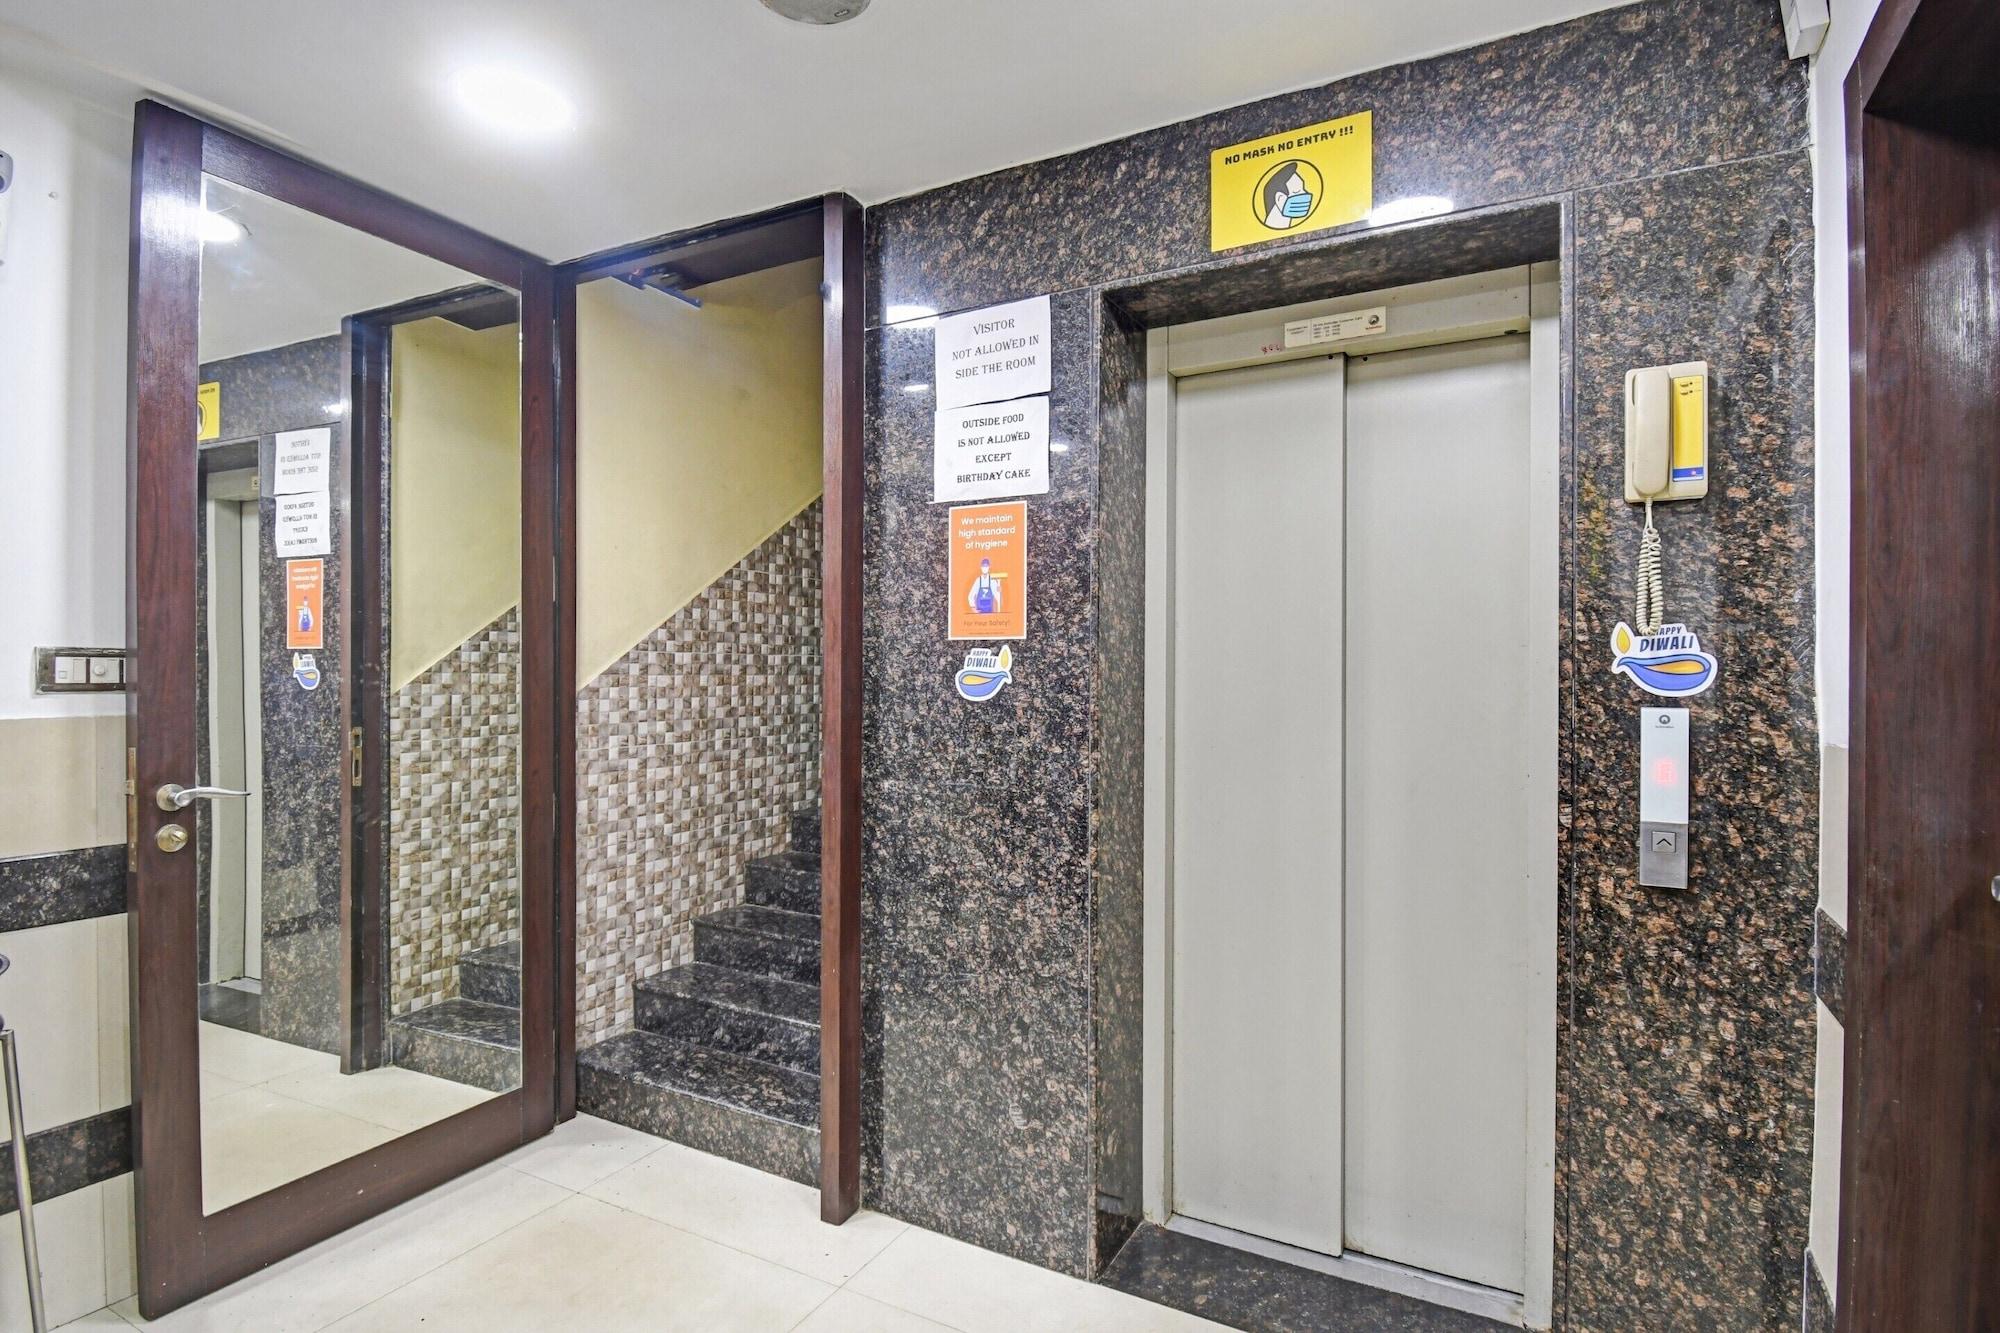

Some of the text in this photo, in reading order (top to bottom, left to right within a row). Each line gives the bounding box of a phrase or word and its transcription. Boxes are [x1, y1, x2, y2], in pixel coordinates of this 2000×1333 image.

[1225, 155, 1240, 165] NO
[1243, 146, 1275, 161] MASK
[1277, 140, 1294, 152] NO
[1297, 130, 1336, 147] ENTRY
[973, 318, 1015, 336] VISITOR
[952, 334, 1039, 361] NOT ALLOWED IN
[955, 355, 1036, 380] SIDE THE ROOM
[962, 413, 1024, 429] OUTSIDE FOOD
[957, 431, 1030, 448] IS NOT ALLOWED
[975, 452, 1012, 464] EXCEPT
[957, 468, 1031, 484] BIRTHDAY CAKE
[961, 514, 1013, 525] We maintain
[958, 526, 1016, 540] high standard
[965, 539, 1008, 551] of hygiene
[1640, 636, 1694, 652] DIWALI
[967, 657, 997, 668] DIWALI
